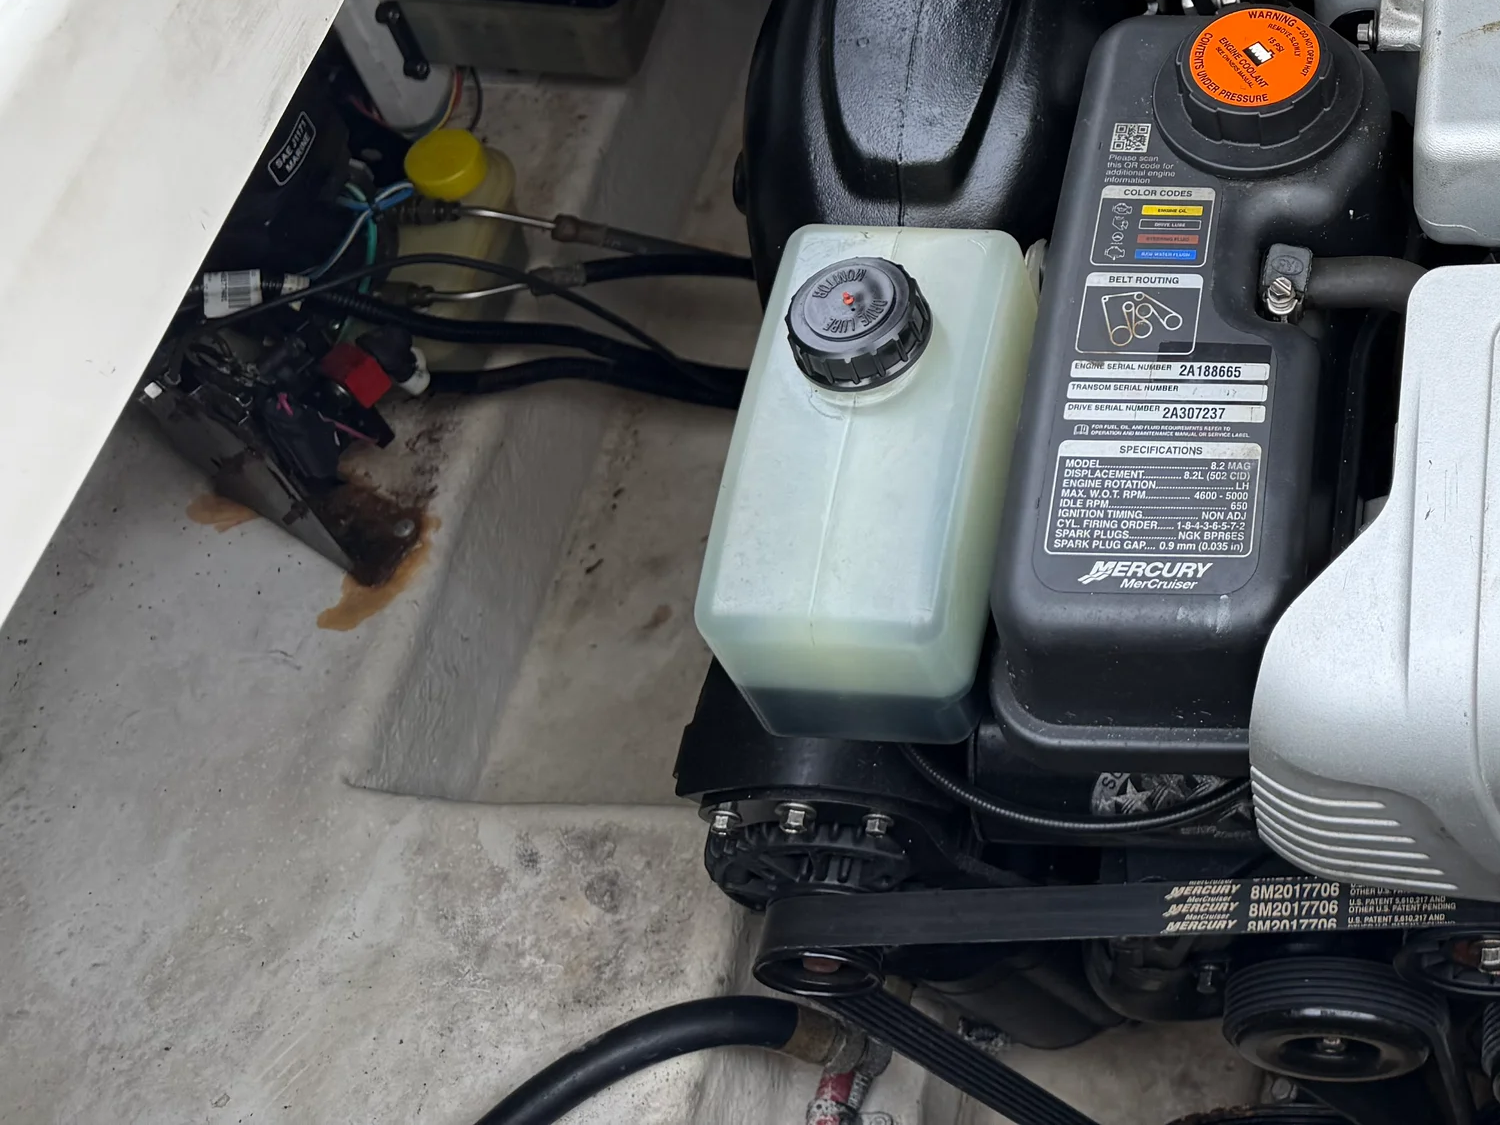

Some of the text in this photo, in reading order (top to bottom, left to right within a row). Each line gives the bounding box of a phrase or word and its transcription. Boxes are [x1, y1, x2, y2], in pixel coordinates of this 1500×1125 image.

[1248, 11, 1297, 27] WARNING
[1268, 23, 1301, 57] REMOVE SLOWLY
[1299, 30, 1308, 39] DO
[1268, 37, 1285, 53] 15 PSI
[1305, 37, 1314, 49] NOT
[1194, 32, 1269, 103] CONTENTS UNDER PRESSURE
[1219, 37, 1269, 88] ENGINE COOLANT
[1301, 64, 1312, 76] HOT
[285, 132, 310, 173] MARINE
[1108, 154, 1137, 162] Please
[1104, 176, 1150, 184] information
[812, 268, 868, 299] MONITOR
[1135, 276, 1179, 284] ROUTING
[861, 299, 887, 327] DRIVE
[1074, 362, 1105, 370] ENGINE
[1179, 364, 1242, 378] 2A188665
[1071, 383, 1112, 391] TRANSOM
[1162, 406, 1226, 419] 2A307237
[1119, 446, 1203, 455] SPECIFICATIONS
[1065, 459, 1251, 470] MODEL 8.2 MAG
[1064, 469, 1251, 481] DISPLACEMENT 8.2L (502 CID)
[1063, 479, 1249, 490] ENGINE ROTATION LH
[1061, 489, 1087, 498] MAX.
[1090, 489, 1120, 498] W.O.T.
[1123, 490, 1146, 499] RPM
[1194, 492, 1217, 500] 4600
[1225, 492, 1248, 500] 5000
[1059, 499, 1248, 510] IDLE RPM 650
[1058, 509, 1247, 520] IGNITION TIMING NON ADJ
[1057, 519, 1246, 530] CYL. FIRING ORDER 1-8-4-3-6-5-7-2
[1055, 529, 1245, 540] SPARK PLUGS NGK BPR6ES
[1053, 539, 1089, 548] SPARK
[1092, 540, 1121, 549] PLUG
[1124, 541, 1146, 549] GAP
[1159, 541, 1175, 550] 0.9
[1198, 542, 1228, 552] (0.035
[1230, 542, 1244, 552] in)
[1078, 560, 1213, 584] MERCURY
[1120, 578, 1198, 590] MerCruiser
[1165, 882, 1340, 900] MERCURY 8M2017706
[1349, 898, 1363, 906] U.S.
[1365, 897, 1393, 905] PATENT
[1429, 895, 1446, 903] AND
[1162, 900, 1457, 917] MERCURY 8M2017706 OTHER U.S. PATENT PENDING
[1348, 916, 1362, 924] U.S.
[1364, 915, 1392, 923] PATENT
[1428, 913, 1445, 921] AND
[1160, 919, 1237, 934] MERCURY
